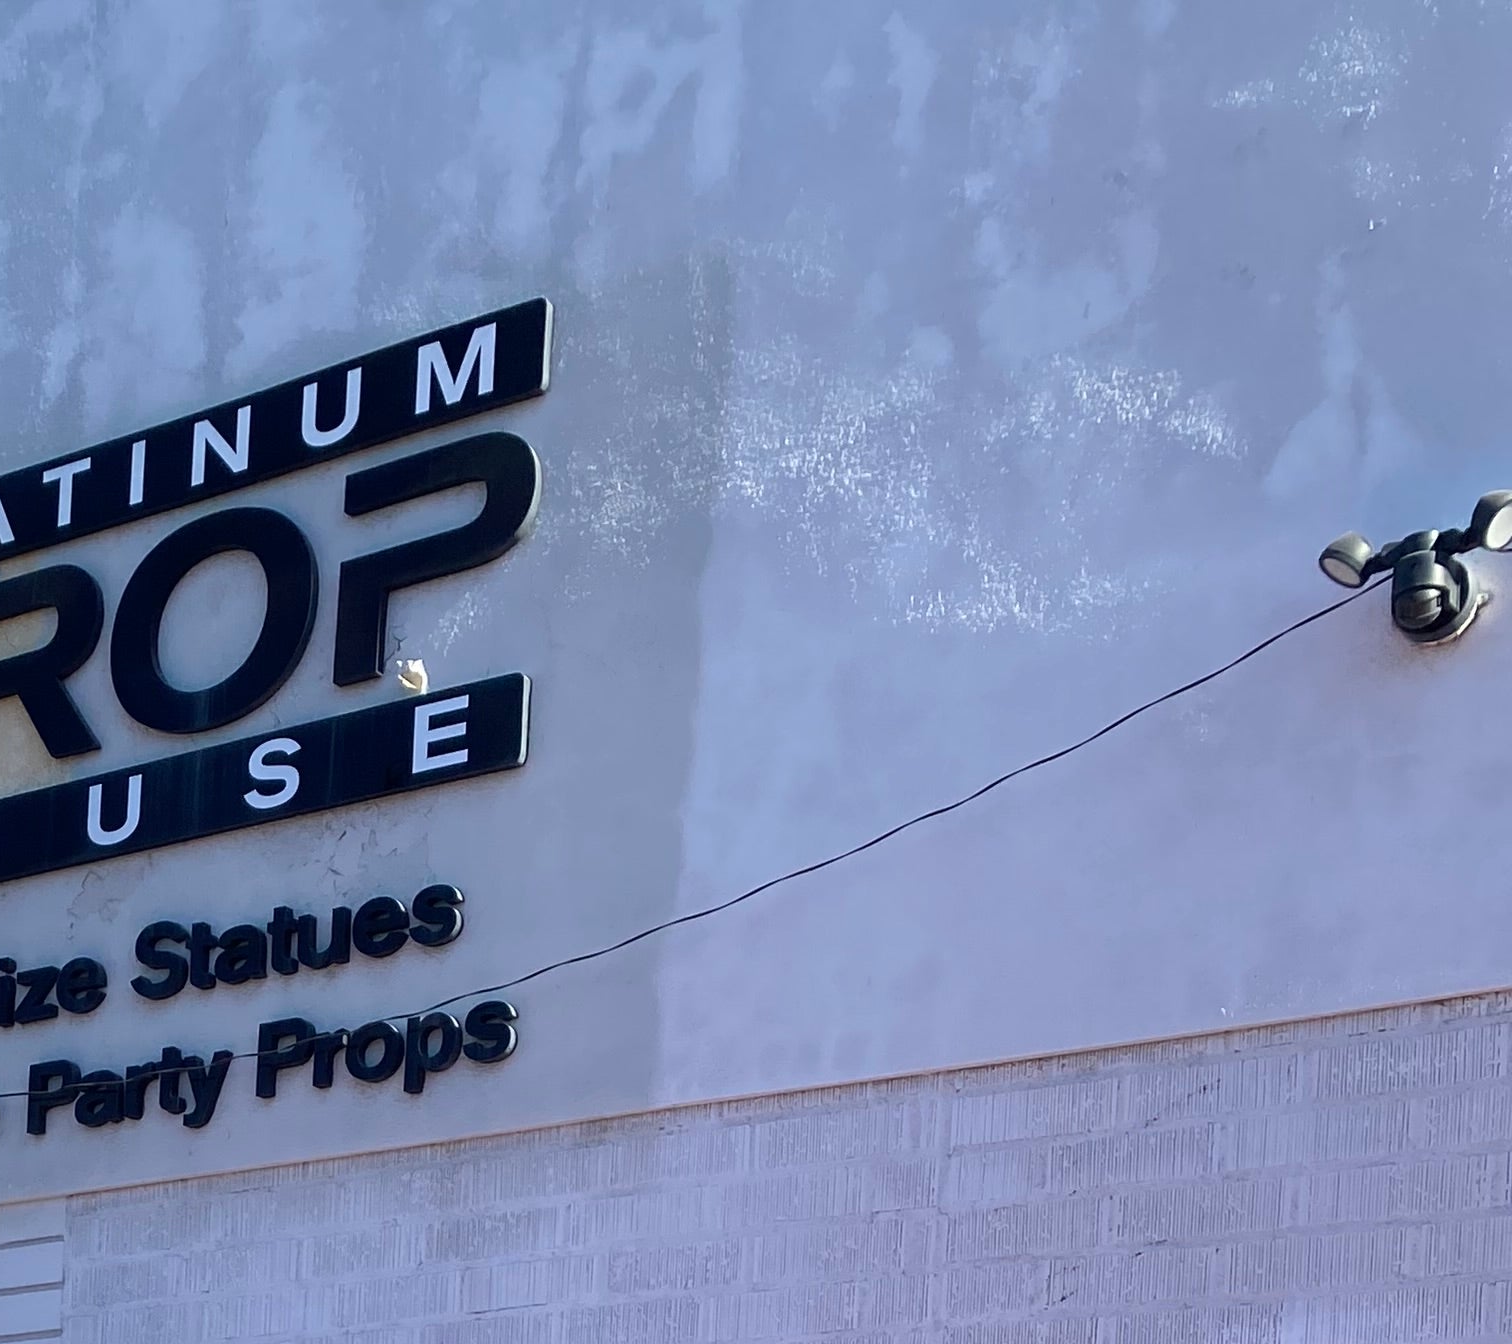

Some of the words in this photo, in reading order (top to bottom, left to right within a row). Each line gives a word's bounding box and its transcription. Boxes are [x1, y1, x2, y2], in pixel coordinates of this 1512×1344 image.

[131, 884, 465, 998] Statues
[27, 1045, 232, 1135] Party
[257, 1000, 519, 1099] Props
